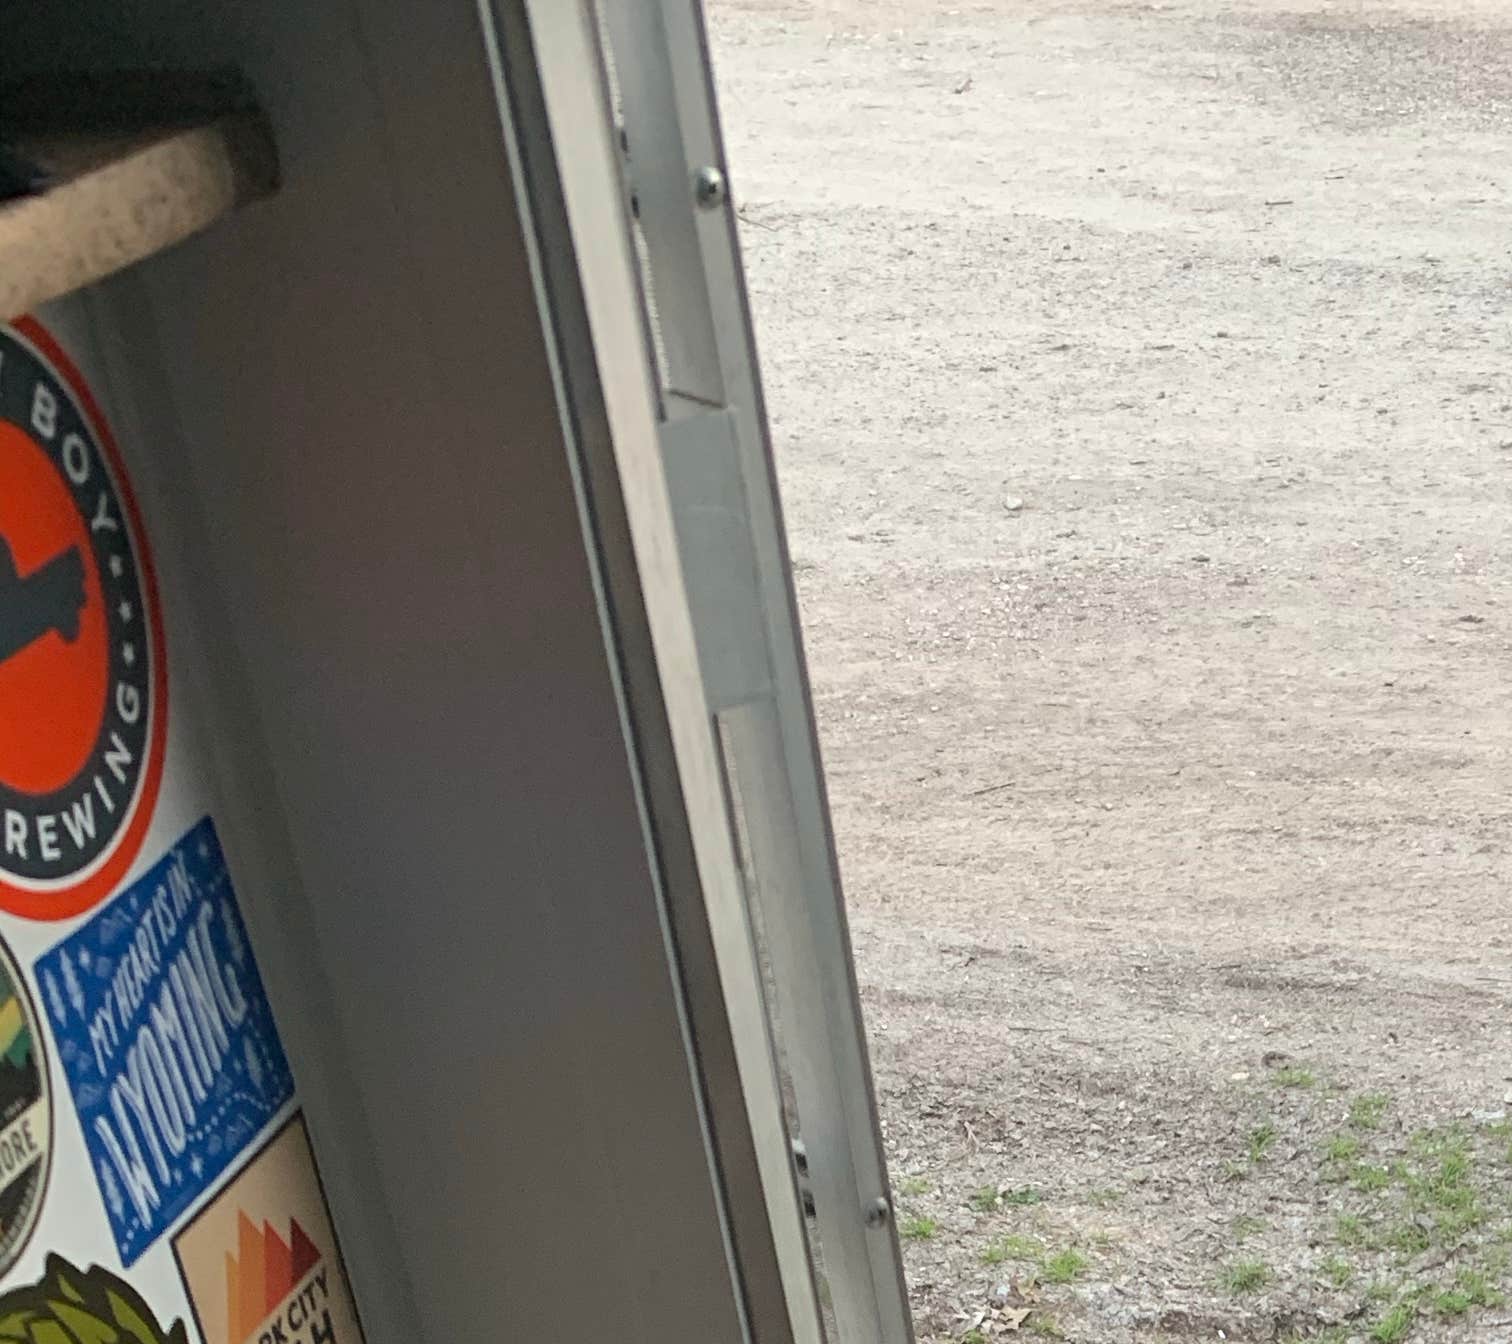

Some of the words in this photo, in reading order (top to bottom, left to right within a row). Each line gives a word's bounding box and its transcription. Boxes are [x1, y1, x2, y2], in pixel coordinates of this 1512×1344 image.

[31, 382, 118, 532] BOY
[4, 680, 141, 863] REWING
[89, 990, 120, 1077] MY
[112, 907, 161, 1031] HEART
[152, 884, 177, 946] IS
[166, 849, 193, 920] IN
[0, 1119, 38, 1175] ORE
[94, 901, 248, 1230] WYOMING
[287, 1266, 329, 1331] CITY
